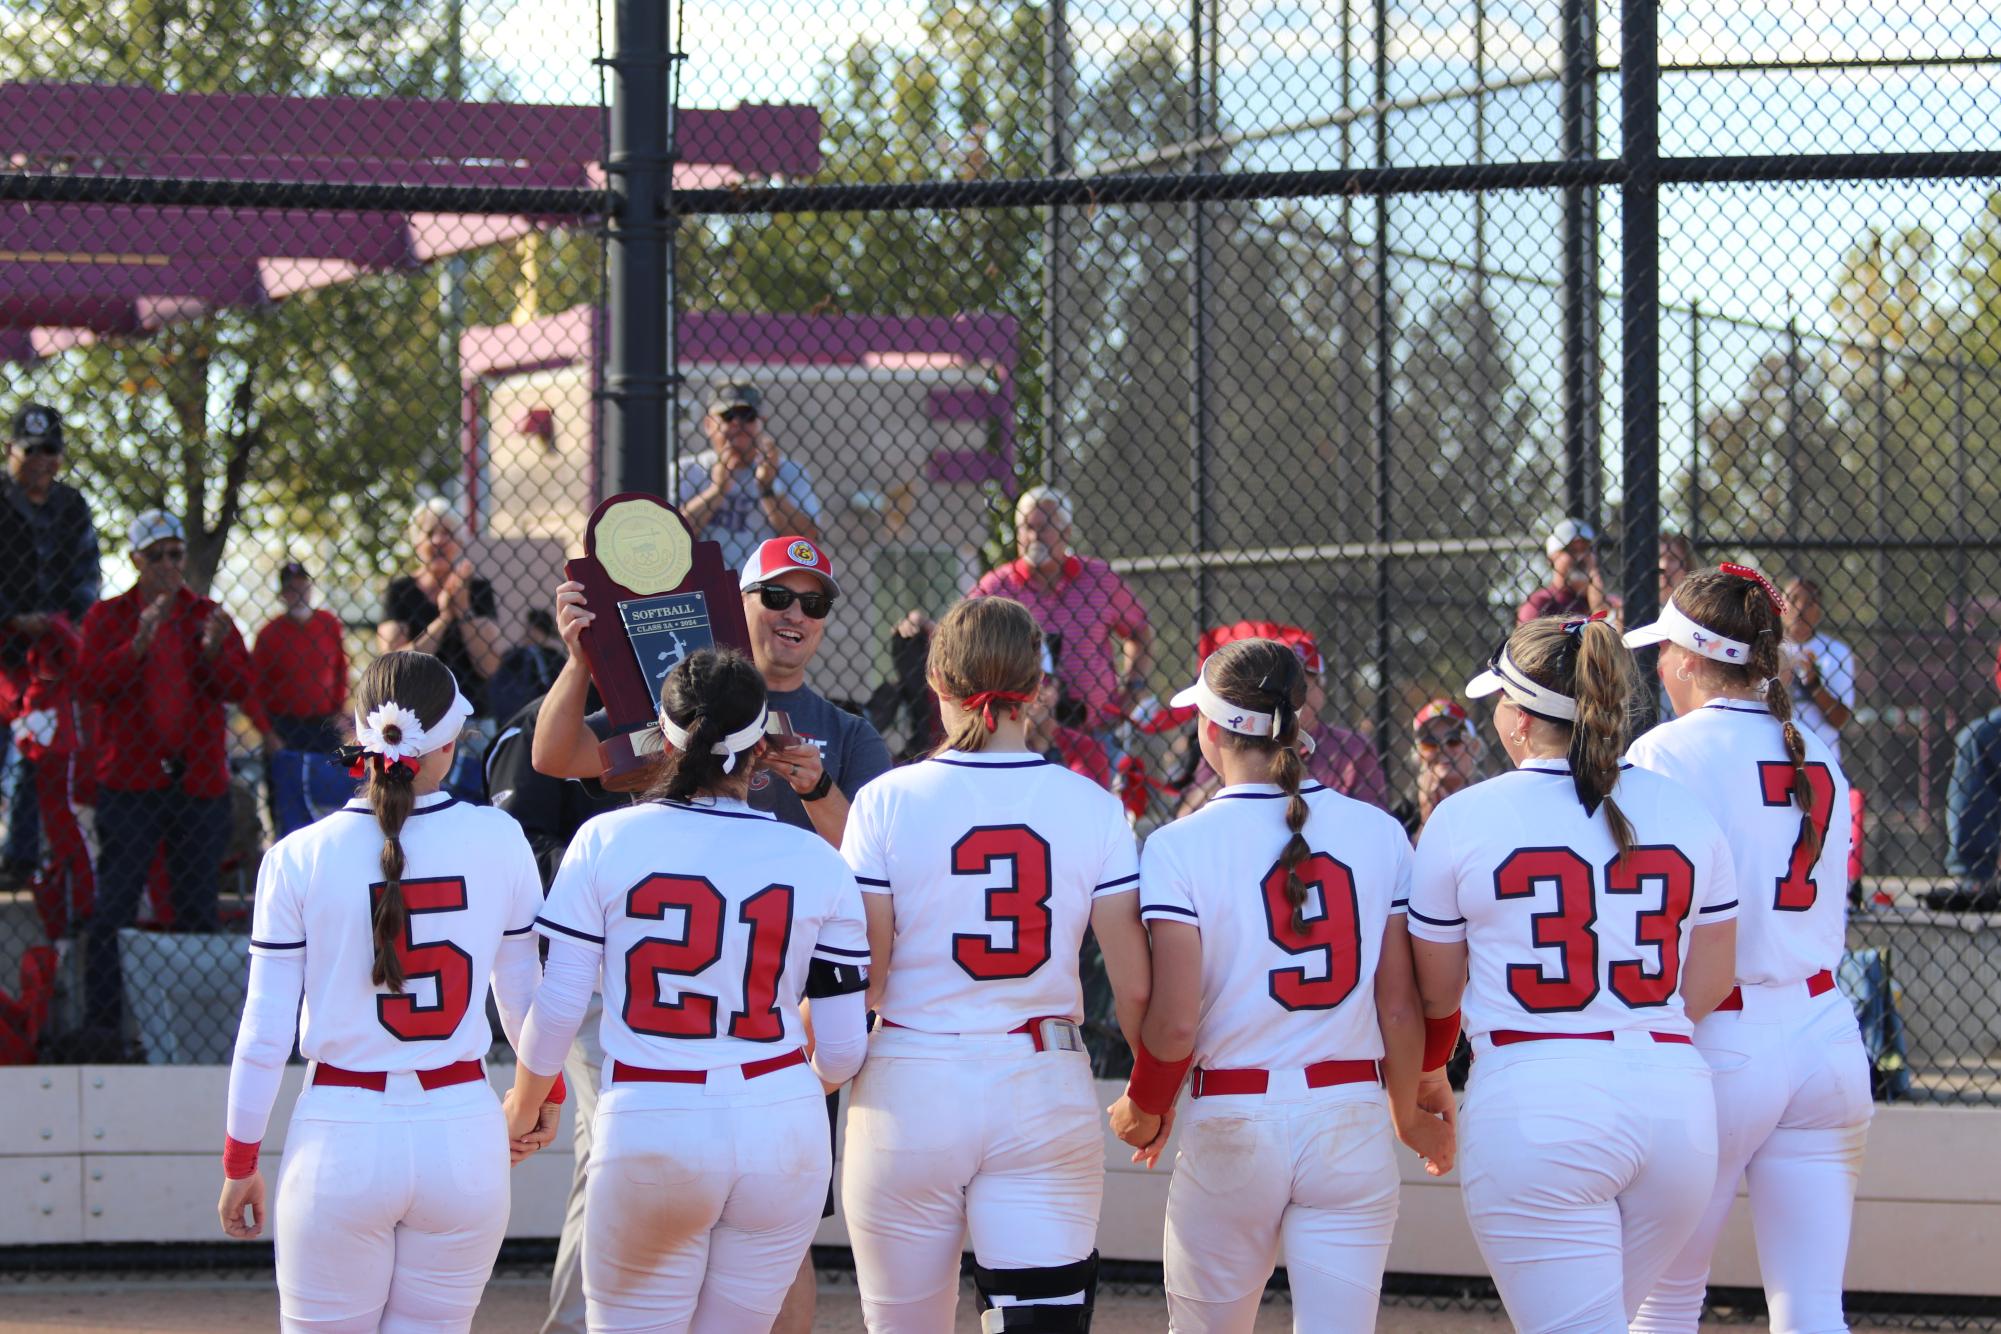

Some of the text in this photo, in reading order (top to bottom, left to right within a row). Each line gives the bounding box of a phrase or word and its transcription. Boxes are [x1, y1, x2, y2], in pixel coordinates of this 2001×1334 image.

[632, 604, 695, 620] SOFTBALL
[637, 623, 663, 633] CLASS
[680, 619, 697, 627] 2024
[951, 824, 1053, 982] 3
[1758, 761, 1836, 911] 7
[370, 876, 472, 1041] 5
[623, 873, 795, 1042] 21
[1261, 852, 1360, 1011] 9
[1494, 845, 1695, 1013] 33
